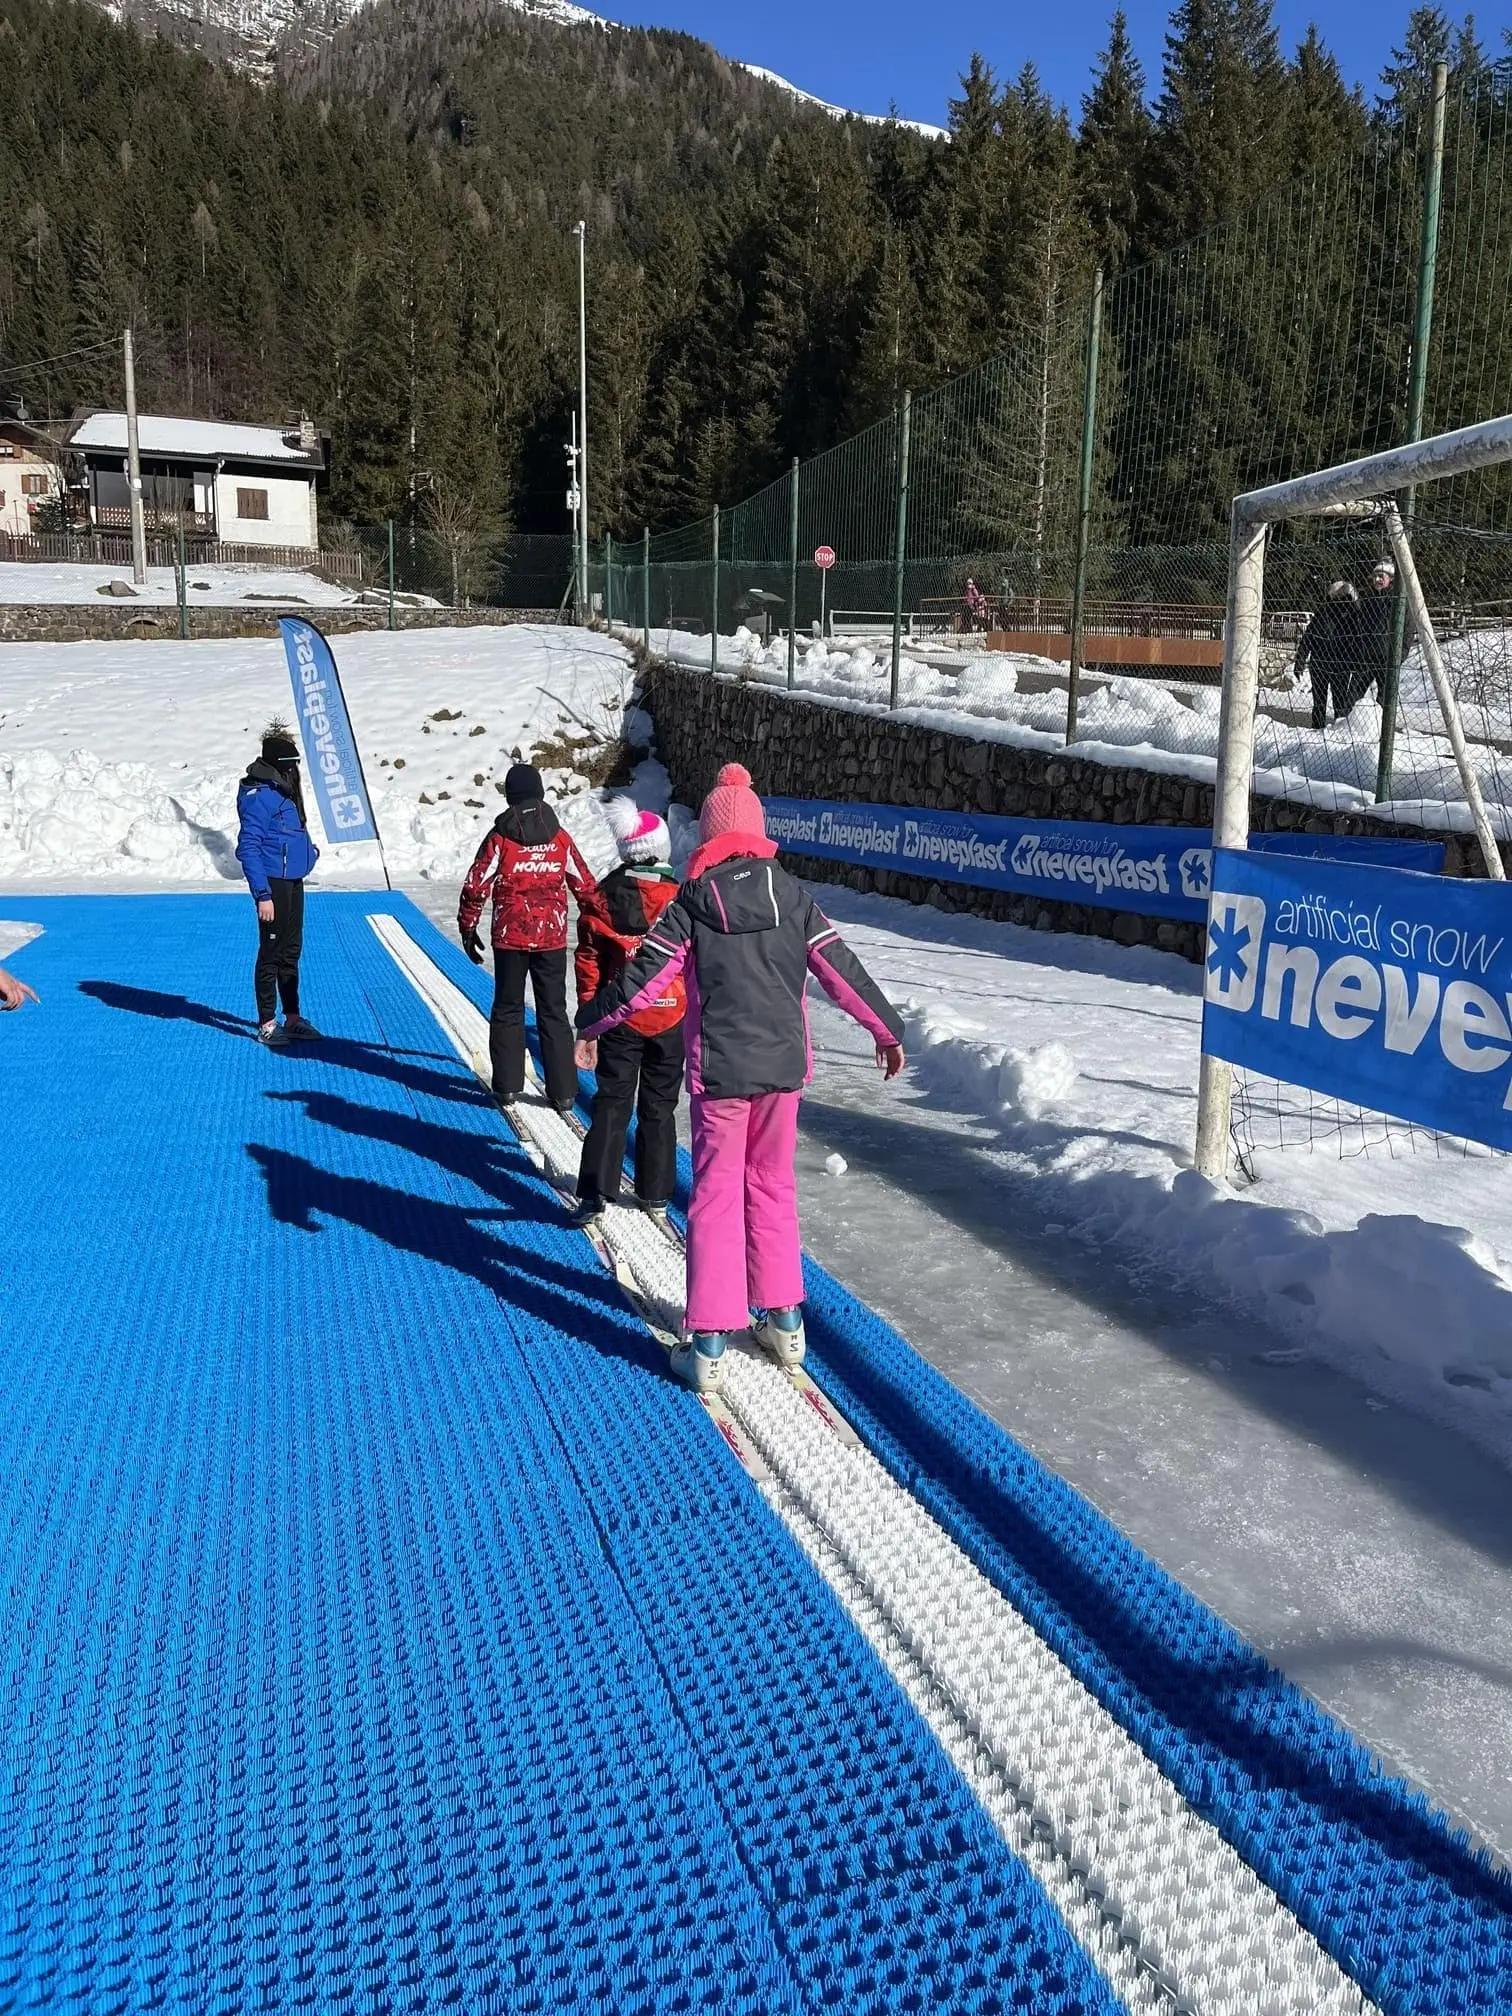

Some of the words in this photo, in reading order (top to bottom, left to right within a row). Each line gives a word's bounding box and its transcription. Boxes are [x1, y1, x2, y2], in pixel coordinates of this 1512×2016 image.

[816, 552, 834, 562] STOP
[766, 812, 817, 844] neveplast
[831, 821, 900, 856] neveplast
[512, 861, 562, 873] MOVING
[918, 833, 1008, 873] neveplast
[1032, 848, 1170, 894] neveplast
[1275, 894, 1382, 952] artificial
[1390, 919, 1504, 974] snow
[1261, 942, 1512, 1112] neve
